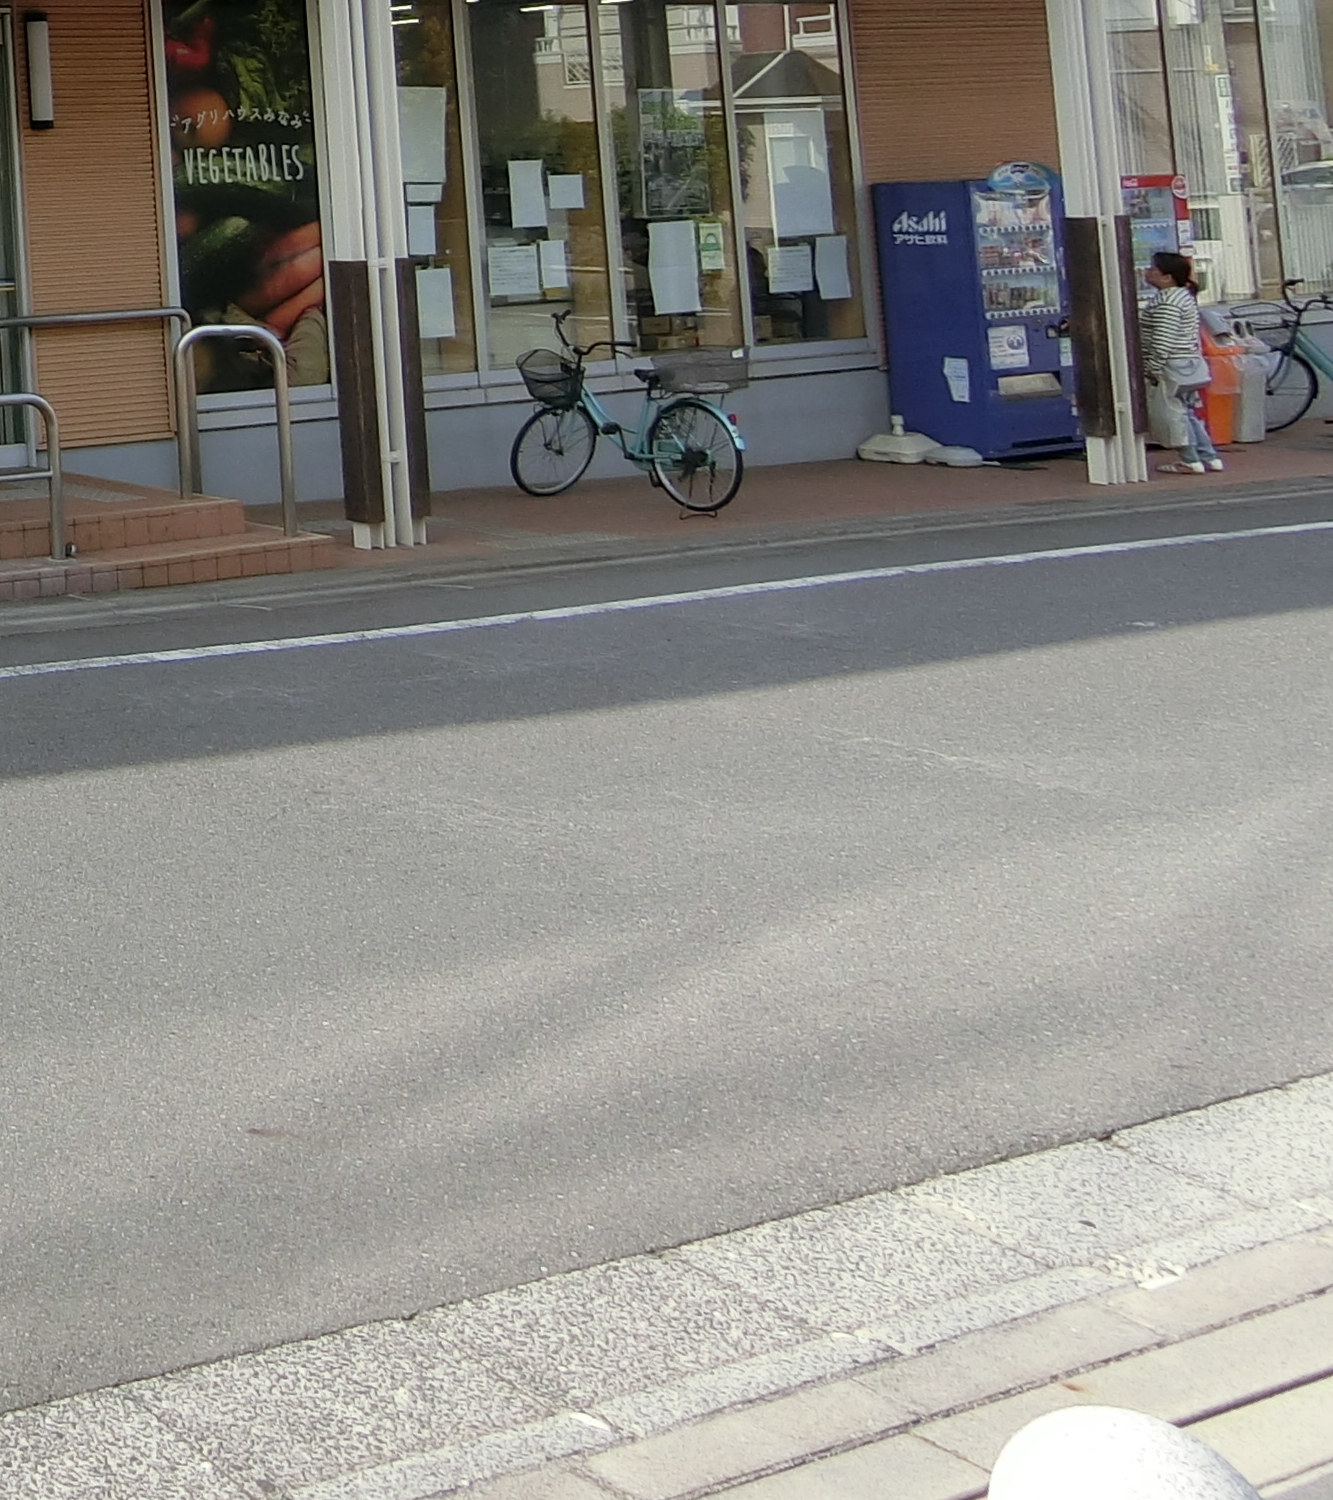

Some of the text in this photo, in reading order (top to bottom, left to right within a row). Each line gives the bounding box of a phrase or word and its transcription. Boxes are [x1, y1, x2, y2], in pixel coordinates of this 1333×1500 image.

[181, 105, 303, 134] アグリハウスみなみ
[183, 143, 305, 185] VEGETABLES
[892, 210, 947, 233] Asahi
[893, 233, 948, 246] アサヒ飲料
